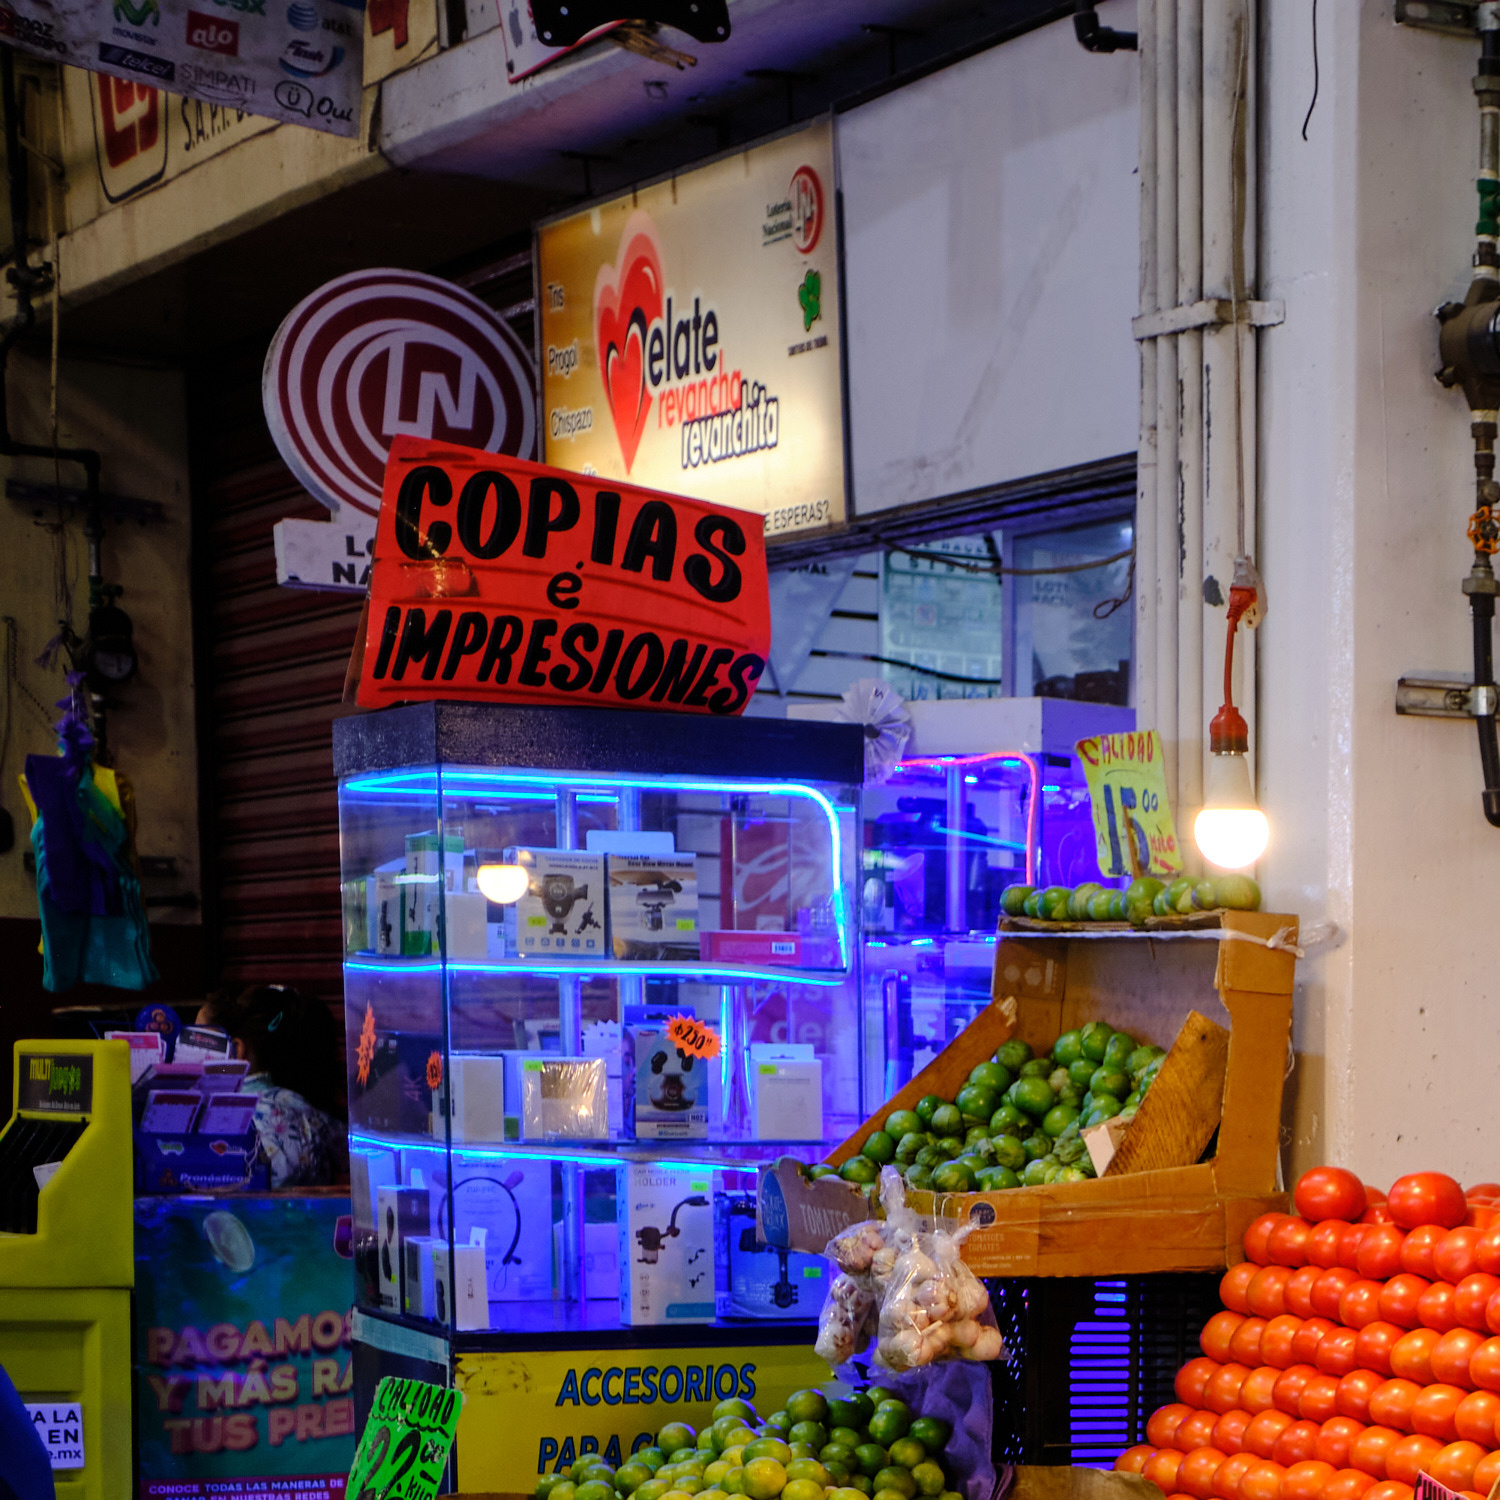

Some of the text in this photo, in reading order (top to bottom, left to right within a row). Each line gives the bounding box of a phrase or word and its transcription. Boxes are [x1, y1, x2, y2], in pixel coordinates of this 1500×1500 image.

[112, 27, 158, 46] movistar
[121, 53, 172, 76] telcel
[548, 338, 579, 379] Progol
[658, 350, 743, 430] revancha
[551, 405, 593, 441] Chispazo
[681, 378, 779, 469] revanchita
[394, 465, 747, 602] COPIAS
[774, 499, 831, 529] ESPERAS?
[373, 605, 766, 715] IMPRESIONES
[1076, 729, 1155, 767] CALIDAD
[146, 1357, 300, 1412] Y MÁS
[377, 1378, 458, 1426] CALIDAD
[555, 1362, 757, 1408] ACCESORIOS
[163, 1412, 259, 1455] TUS
[149, 1477, 344, 1495] CONOCE TODAS LAS MANERAS DE
